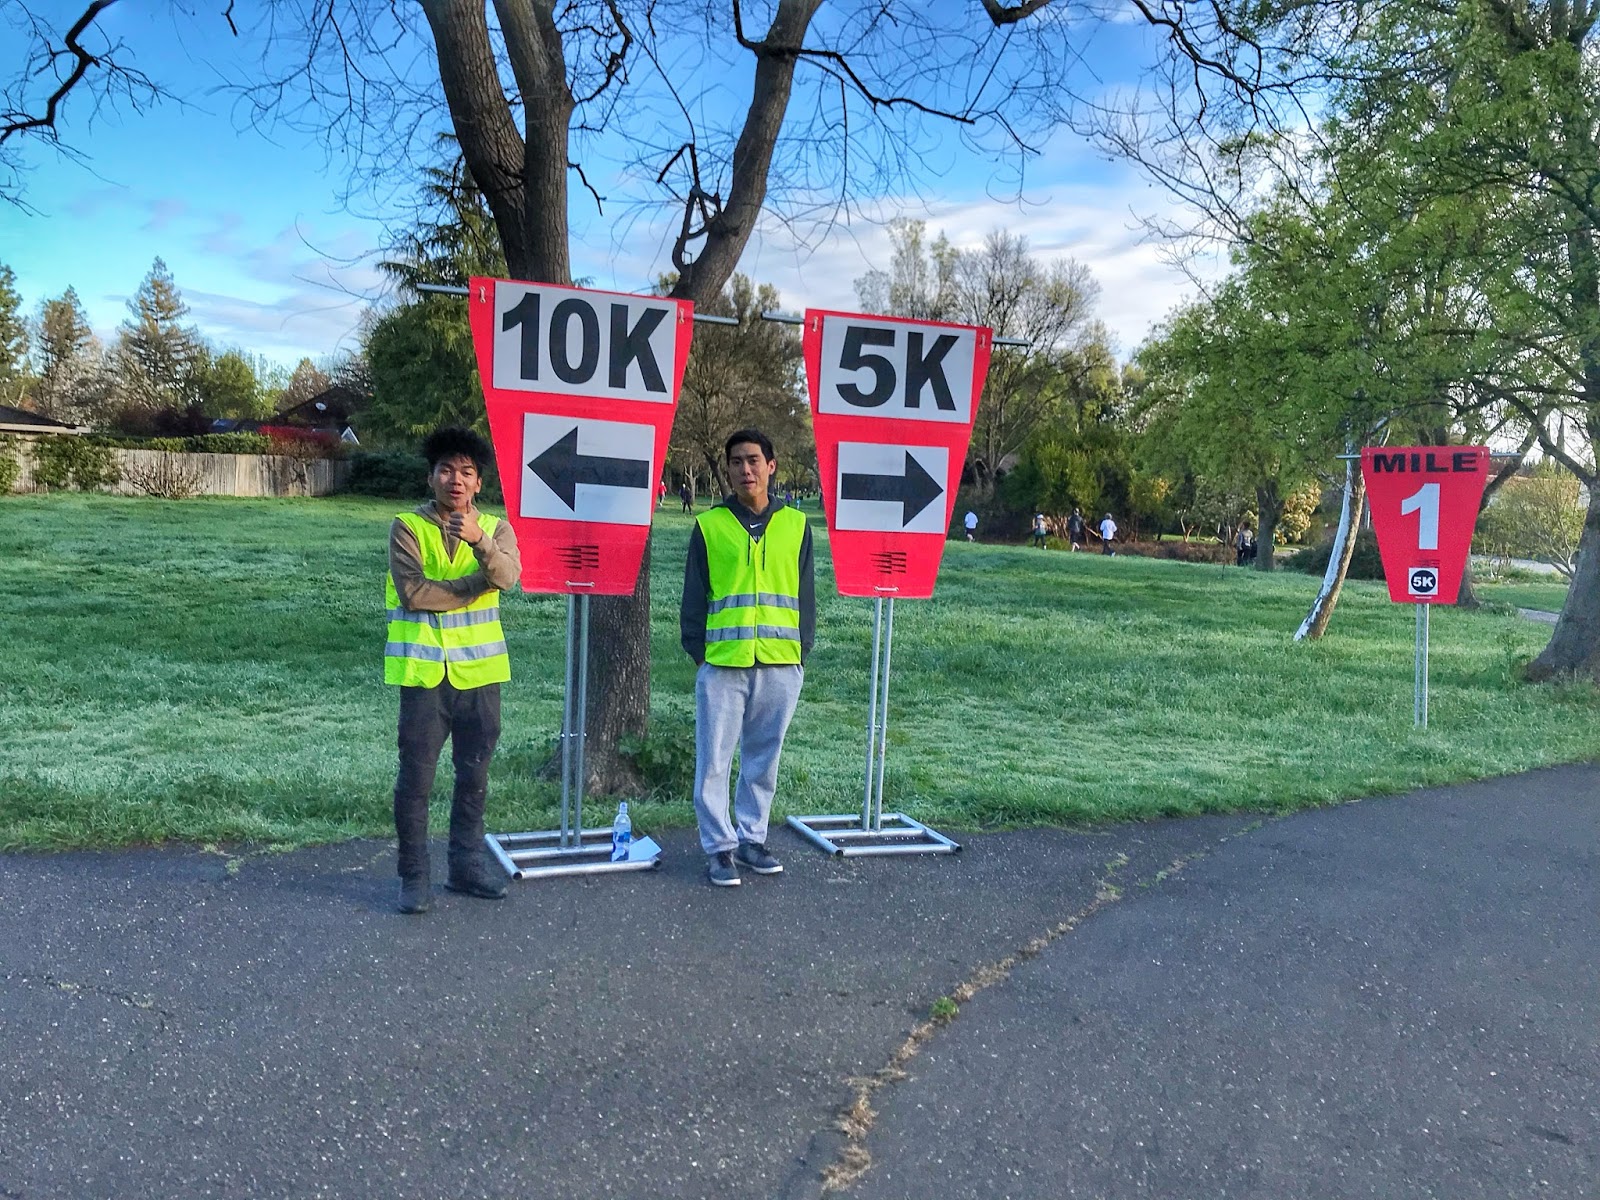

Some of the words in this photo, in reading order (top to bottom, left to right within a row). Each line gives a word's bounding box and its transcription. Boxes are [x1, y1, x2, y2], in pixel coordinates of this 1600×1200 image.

[502, 292, 669, 393] 10K
[836, 326, 960, 411] 5K
[1373, 452, 1478, 473] MILE
[1401, 483, 1440, 550] 1
[1412, 576, 1434, 588] 5K
